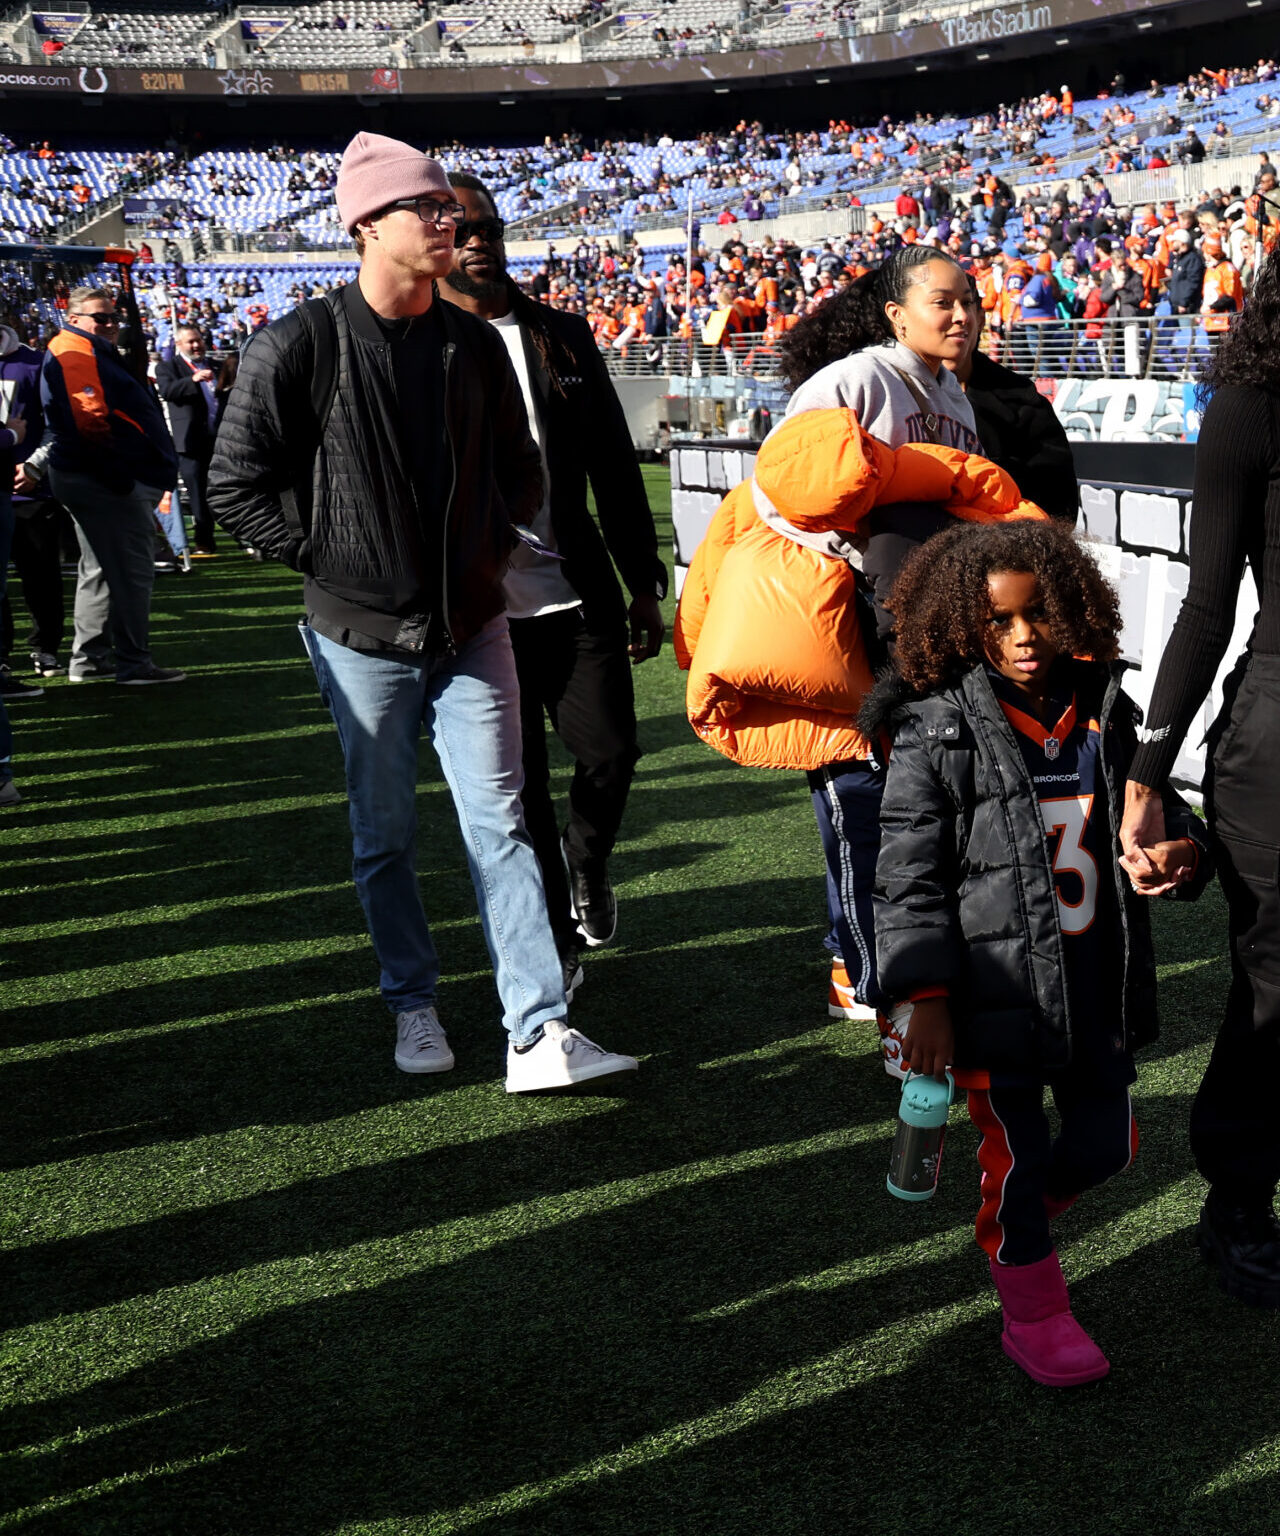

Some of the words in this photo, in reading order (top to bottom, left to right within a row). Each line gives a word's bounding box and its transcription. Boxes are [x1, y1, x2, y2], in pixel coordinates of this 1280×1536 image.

[957, 14, 993, 45] Bank
[992, 4, 1052, 38] Stadium
[1033, 773, 1080, 784] BRONCOS
[1039, 794, 1099, 935] 3
